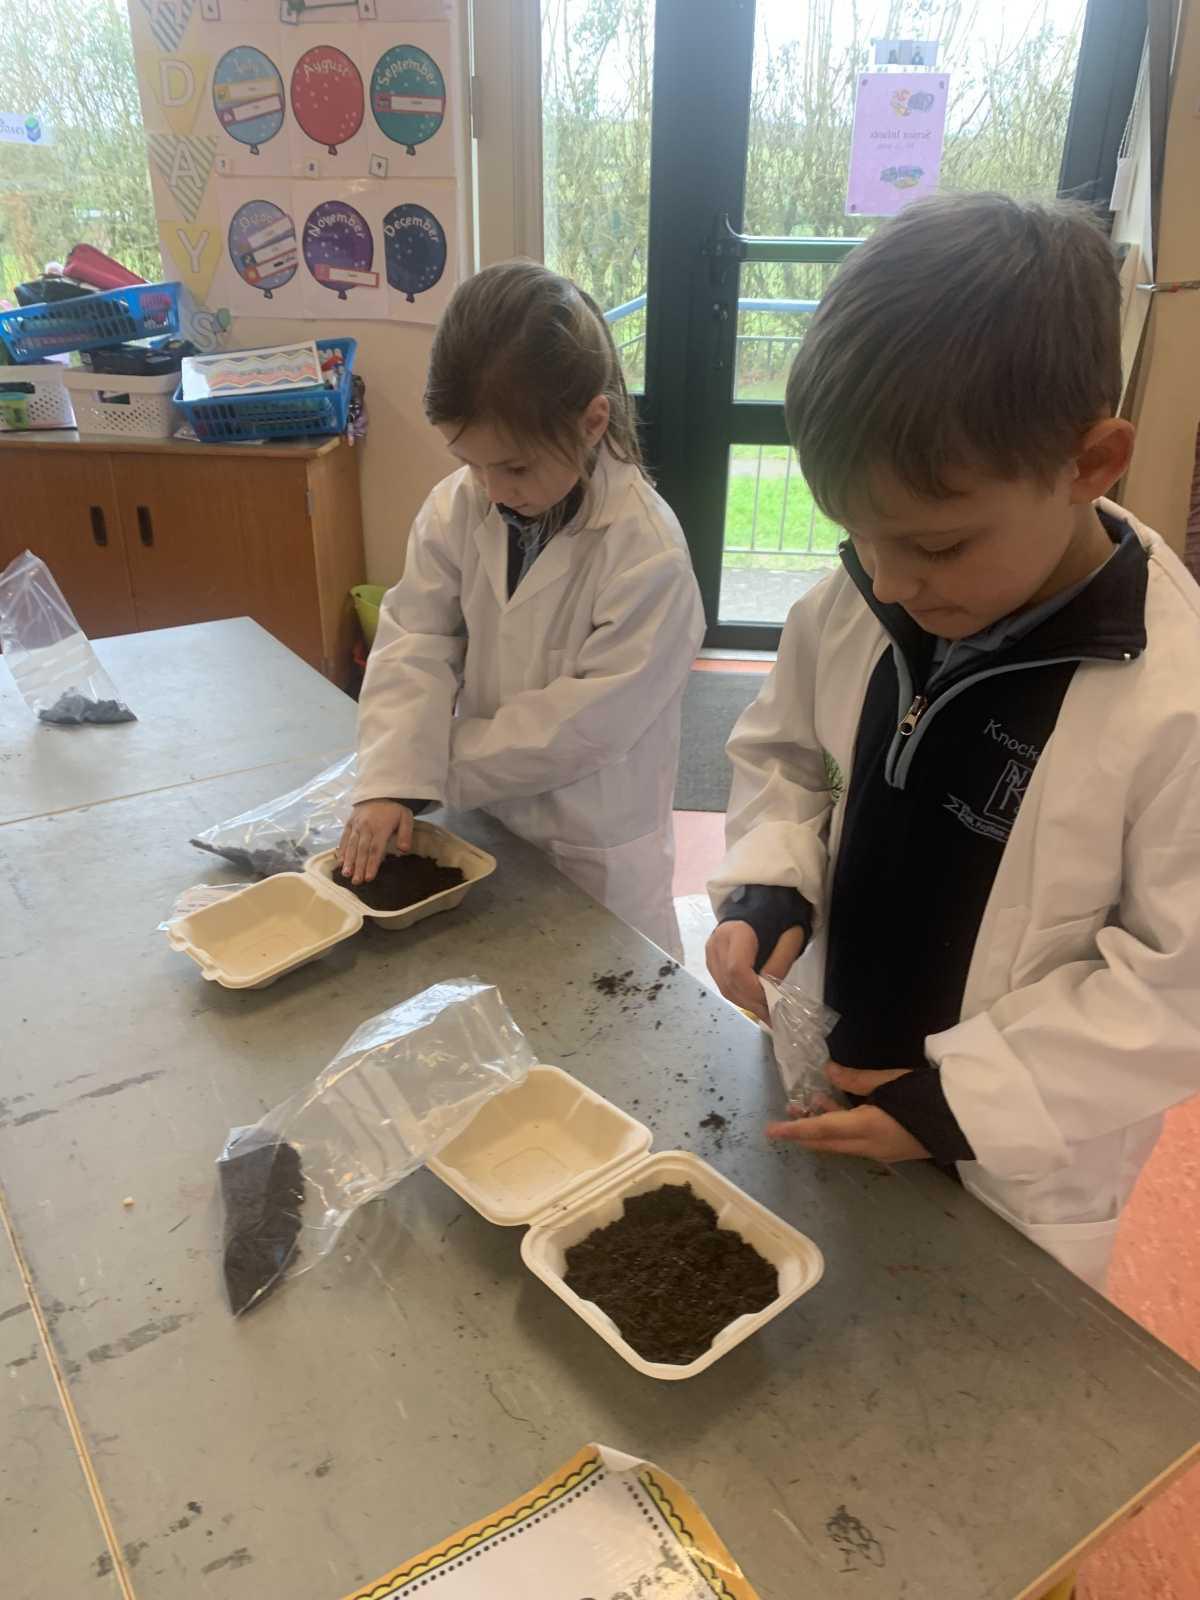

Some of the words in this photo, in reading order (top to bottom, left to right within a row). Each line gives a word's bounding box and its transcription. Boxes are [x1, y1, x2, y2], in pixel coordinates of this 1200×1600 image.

[303, 59, 351, 79] August
[377, 57, 437, 87] September
[308, 212, 366, 239] November
[383, 216, 440, 242] December
